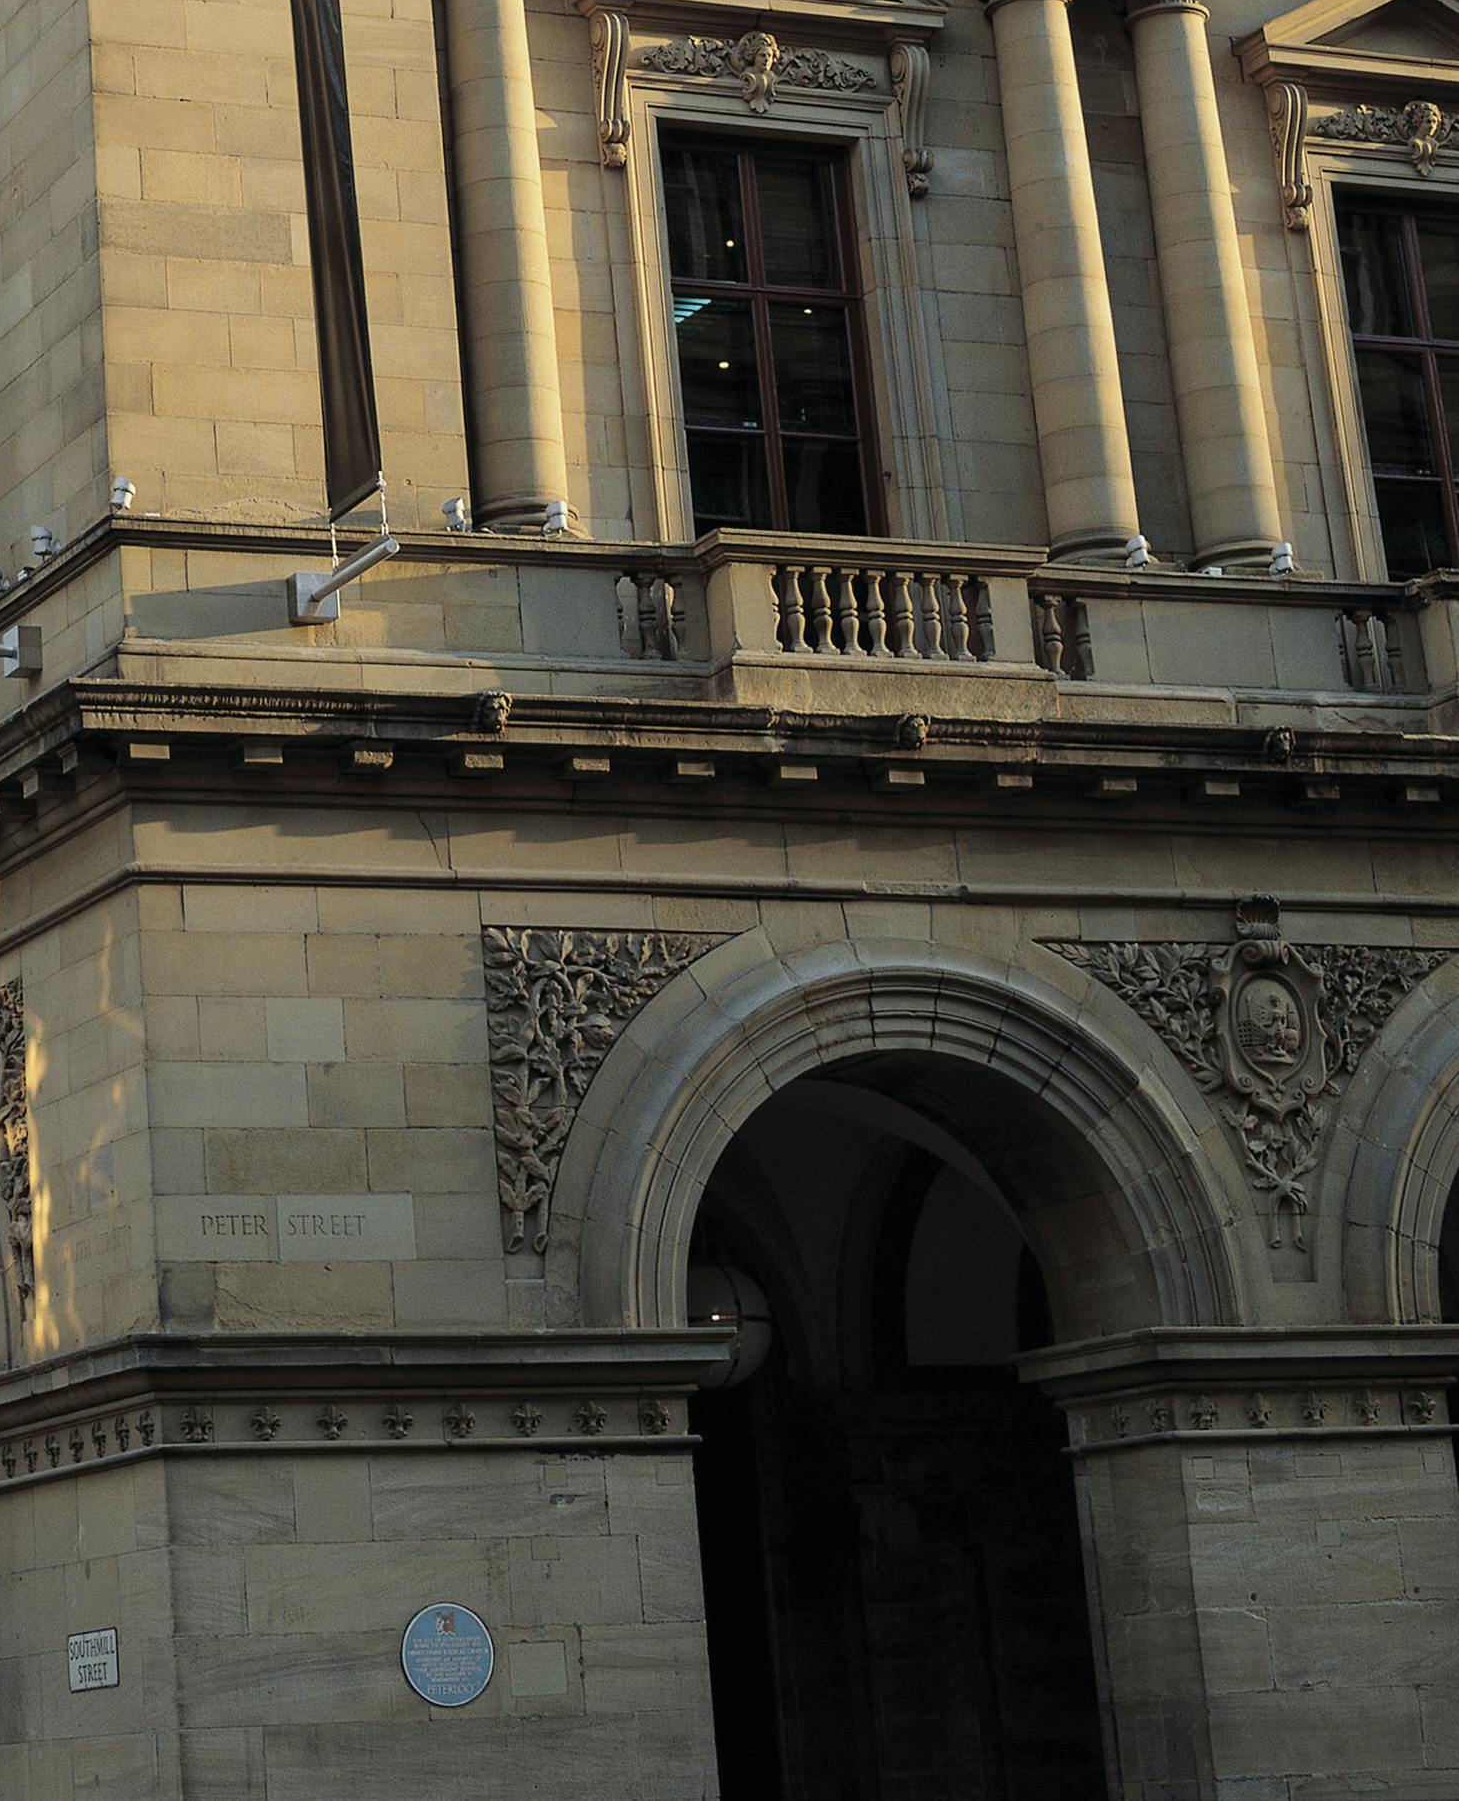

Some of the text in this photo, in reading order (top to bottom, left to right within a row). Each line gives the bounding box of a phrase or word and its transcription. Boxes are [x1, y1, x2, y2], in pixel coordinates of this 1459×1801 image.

[201, 1214, 366, 1236] PETER STREET
[69, 1635, 115, 1660] SOUTHMILL
[78, 1662, 107, 1684] STREET
